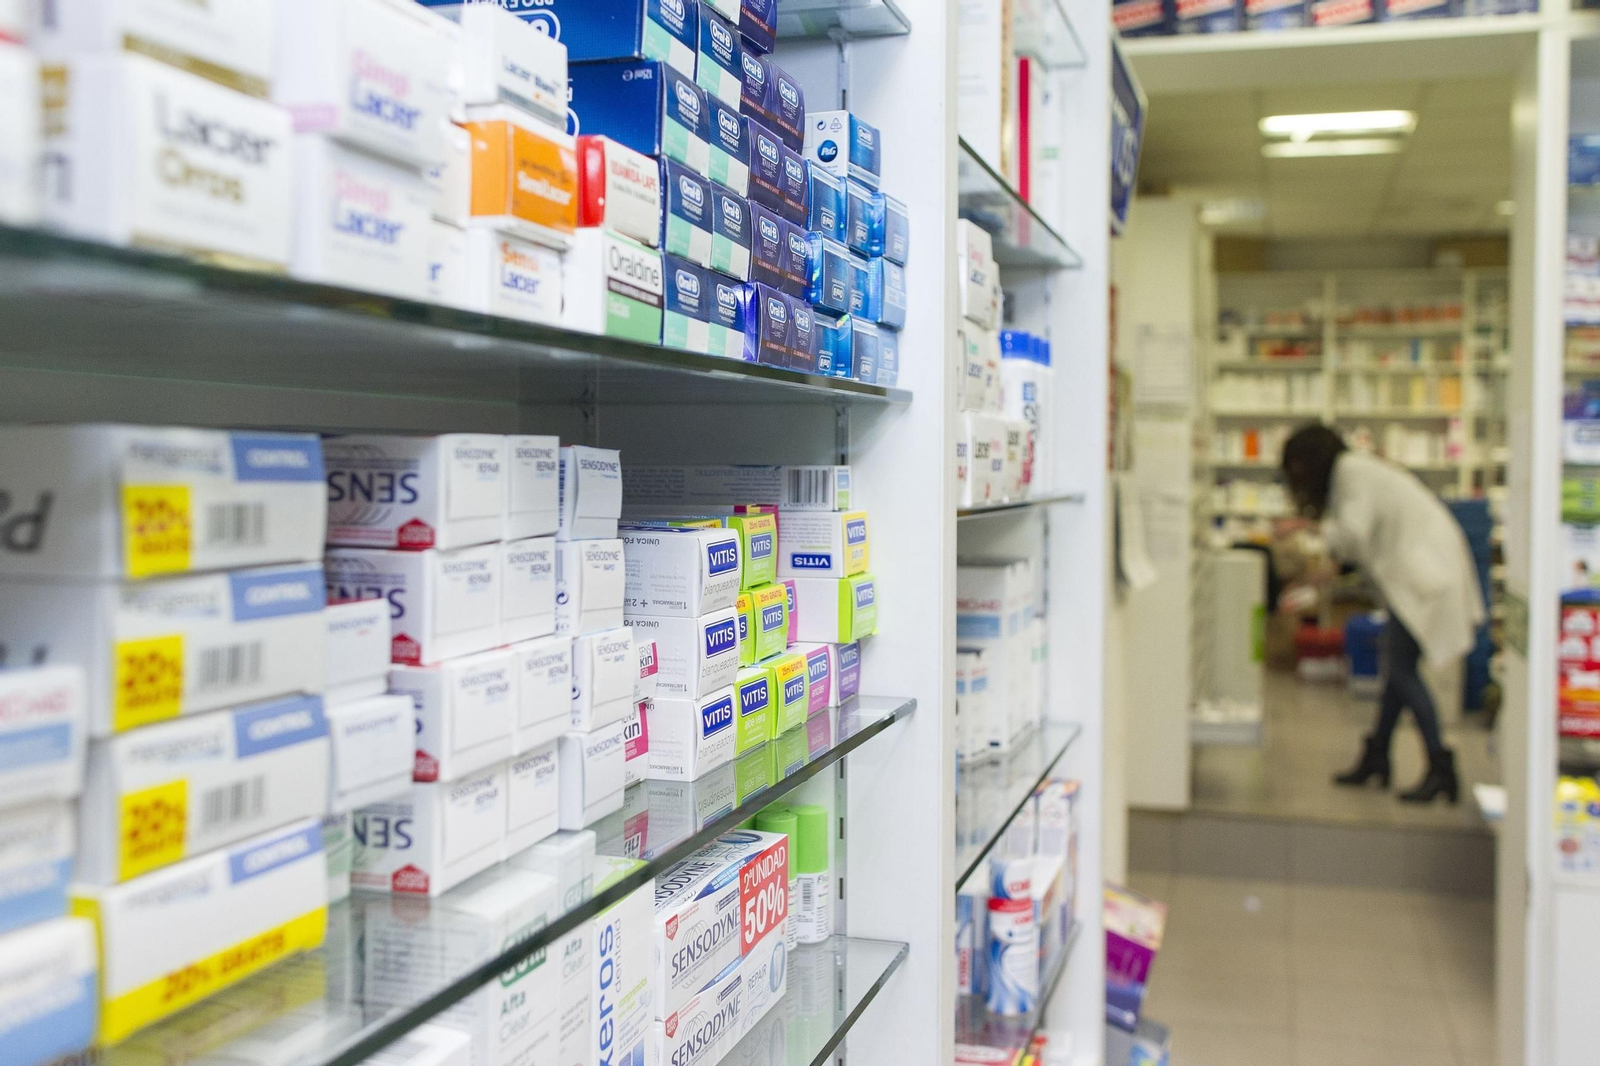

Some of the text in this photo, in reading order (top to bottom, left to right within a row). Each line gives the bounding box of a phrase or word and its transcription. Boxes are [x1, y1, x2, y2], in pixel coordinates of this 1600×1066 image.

[712, 24, 732, 45] Oral-B
[744, 56, 762, 78] Oral-B
[349, 75, 422, 130] Lacer
[678, 88, 697, 109] Oral-B
[779, 84, 797, 103] Oral-B
[155, 89, 277, 166] Lacer
[720, 116, 738, 134] Oral-B
[759, 140, 777, 159] Oral-B
[821, 147, 836, 156] P&G
[785, 161, 802, 179] Oral-B
[681, 181, 701, 200] Oral-B
[723, 201, 740, 219] Oral-B
[330, 197, 405, 245] Lacer
[760, 223, 777, 239] Oral-B
[790, 238, 805, 254] Oral-B
[608, 245, 660, 287] Oraldine
[500, 266, 541, 294] Lacer
[678, 274, 698, 293] Oral-B
[718, 289, 735, 305] Oral-B
[769, 302, 785, 318] Oral-B
[795, 313, 809, 329] Oral-B
[515, 447, 555, 459] SENSODYNE
[580, 458, 619, 472] SENSODYNE
[758, 518, 771, 528] GRATIS
[637, 537, 660, 547] ÚNICA
[847, 525, 866, 541] VITIS
[752, 538, 771, 553] VITIS
[508, 550, 550, 563] SENSODYNE
[585, 550, 621, 562] SENSODYNE
[710, 548, 736, 567] VITIS
[794, 557, 829, 566] VITIS
[530, 563, 552, 574] REPAIR
[704, 576, 740, 596] blanqueadora
[770, 589, 782, 600] GRATIS
[857, 587, 874, 603] VITIS
[635, 620, 659, 630] ÚNICA
[763, 611, 783, 625] VITIS
[708, 627, 734, 647] VITIS
[596, 639, 631, 656] SENSODYNE
[840, 648, 857, 664] VITIS
[525, 652, 567, 670] SENSODYNE
[701, 656, 738, 678] blanqueadora
[781, 660, 803, 676] 25ml GRATIS
[808, 659, 827, 677] VITIS
[742, 686, 767, 706] VITIS
[785, 682, 804, 696] VITIS
[704, 705, 731, 728] VITIS
[744, 713, 765, 730] aloe vera
[585, 734, 622, 758] SENSODYNE
[698, 733, 735, 759] blanqueadora
[512, 751, 553, 774] SENSODYNE
[744, 874, 785, 944] 50%
[671, 903, 741, 978] SENSODYNE
[613, 918, 622, 994] dentaid
[747, 963, 767, 990] REPAIR
[671, 992, 743, 1066] SENSODYNE
